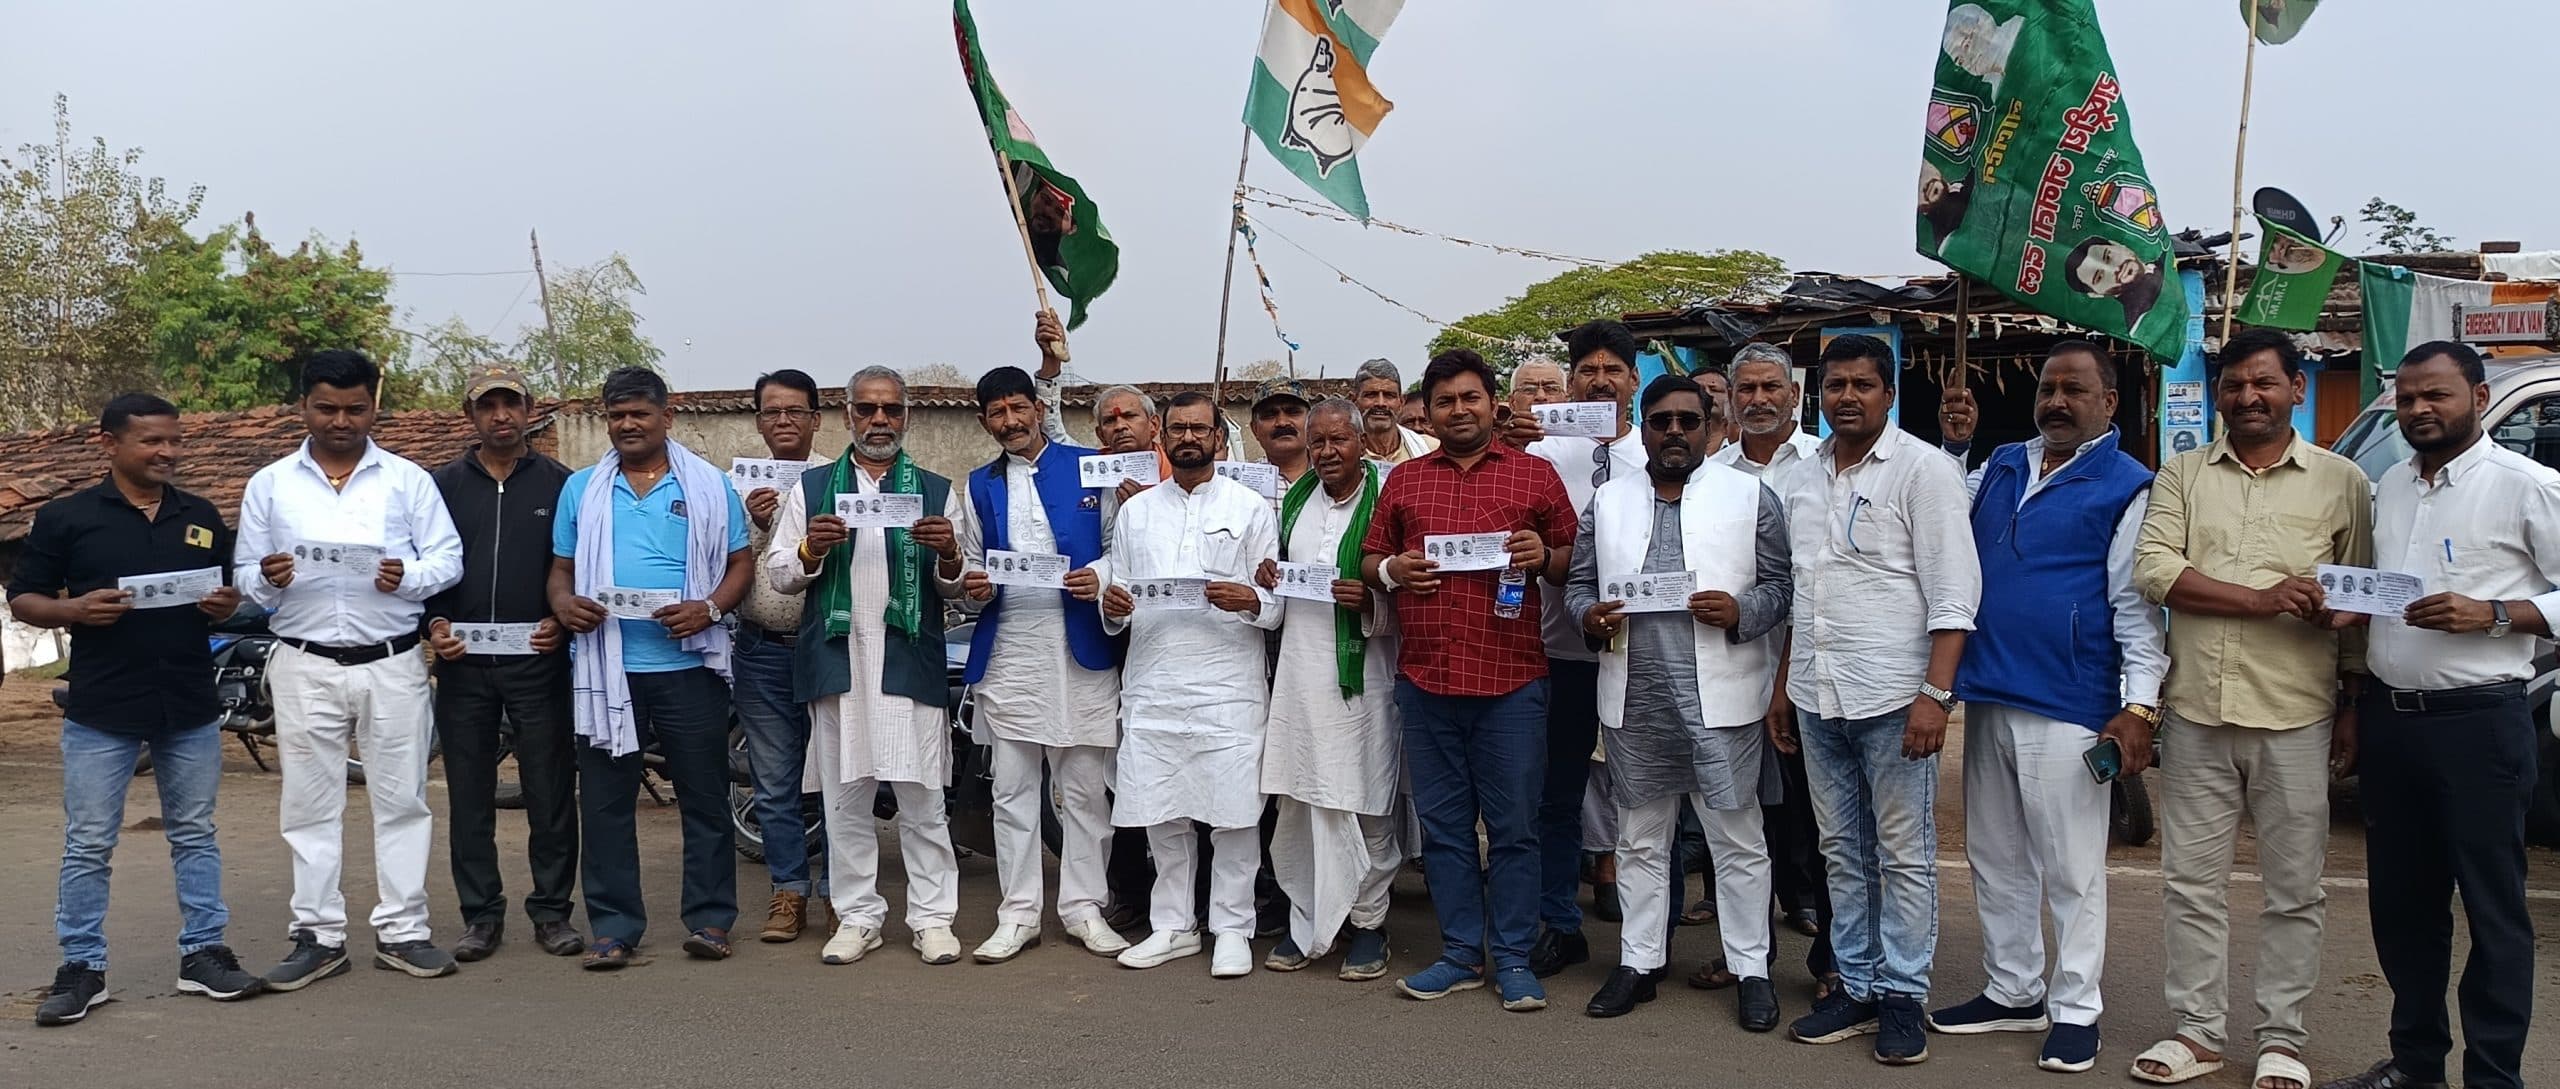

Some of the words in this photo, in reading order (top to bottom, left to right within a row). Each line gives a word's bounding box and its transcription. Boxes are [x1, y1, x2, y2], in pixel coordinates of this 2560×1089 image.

[2465, 311, 2507, 335] EMERGENCY
[2507, 310, 2526, 334] MILK
[2527, 310, 2543, 334] VAN
[903, 545, 915, 582] RJD
